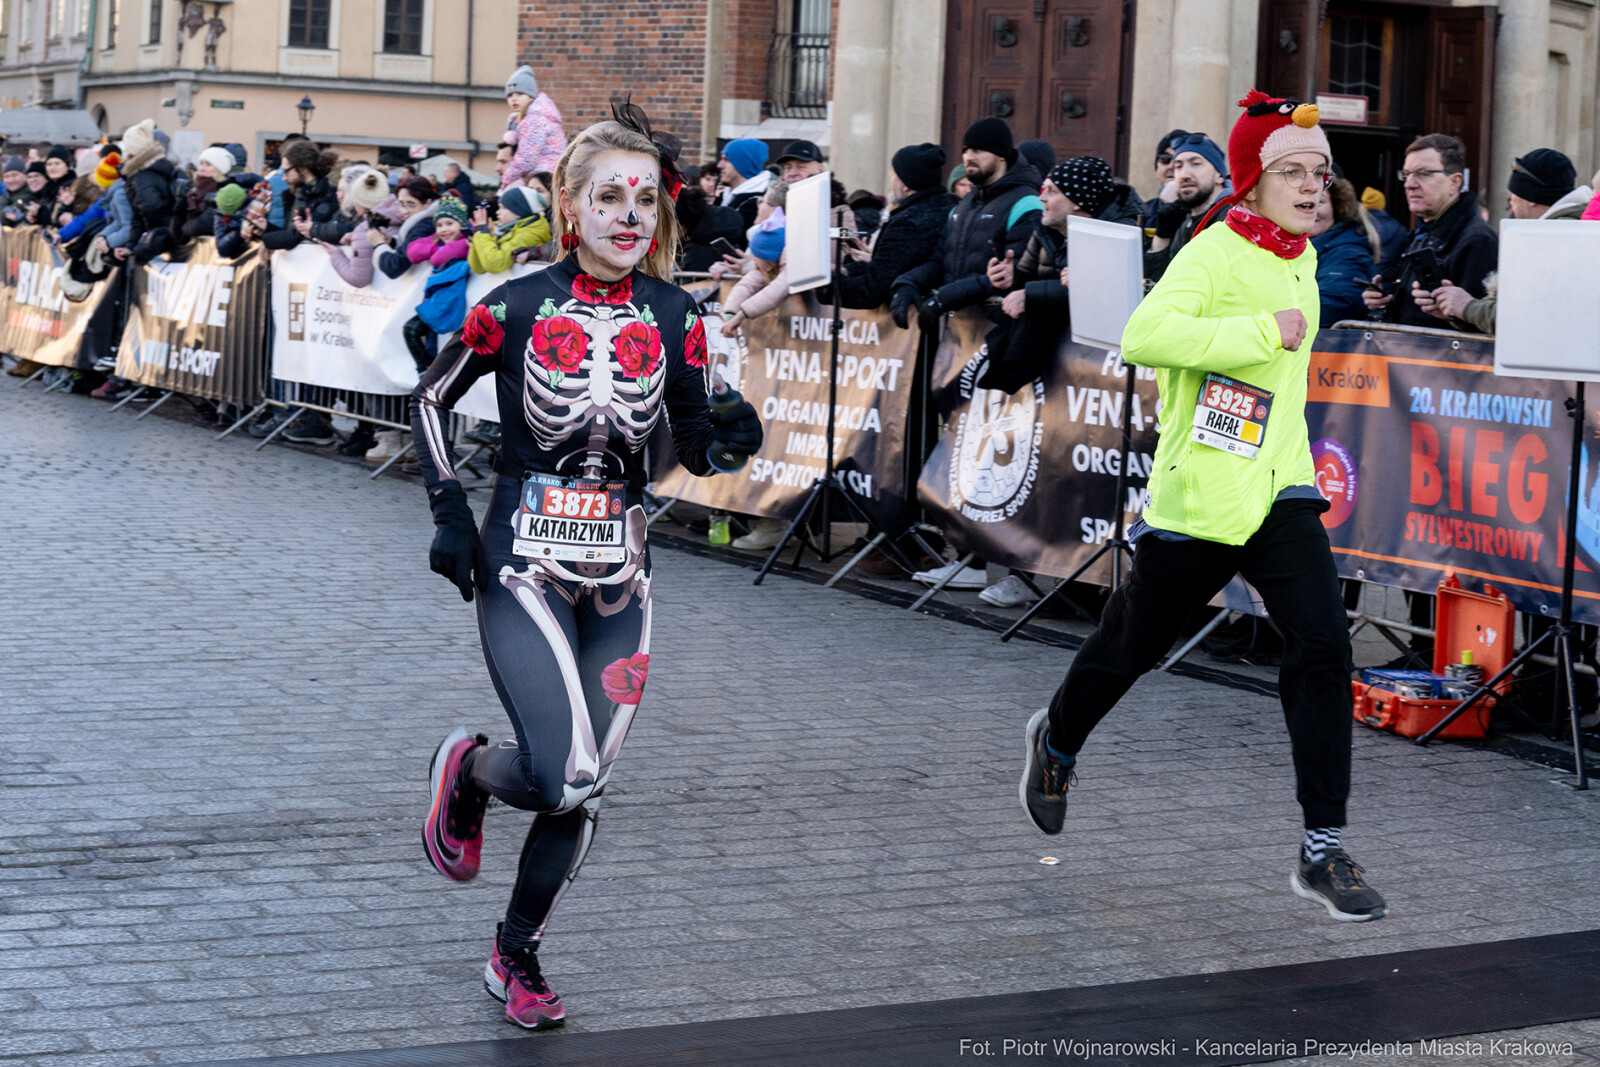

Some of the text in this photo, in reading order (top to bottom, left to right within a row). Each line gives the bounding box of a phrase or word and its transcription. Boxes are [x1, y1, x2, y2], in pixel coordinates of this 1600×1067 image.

[790, 315, 880, 345] FUNDACJA
[179, 346, 221, 377] SPORT
[765, 348, 904, 392] VENA-SPORT
[1317, 367, 1381, 391] Kraków
[1207, 385, 1254, 417] 3925
[1409, 386, 1553, 429] 20. KRAKOWSKI
[1206, 411, 1239, 436] RAFAŁ
[785, 431, 843, 460] IMPRZ
[961, 504, 1007, 524] IMPREZ
[1005, 421, 1045, 520] SPORTOWYCH
[1409, 420, 1549, 525] BIEG
[546, 489, 607, 518] 3873
[528, 516, 614, 542] KATARZYNA
[1404, 511, 1545, 563] SYLWESTROWY
